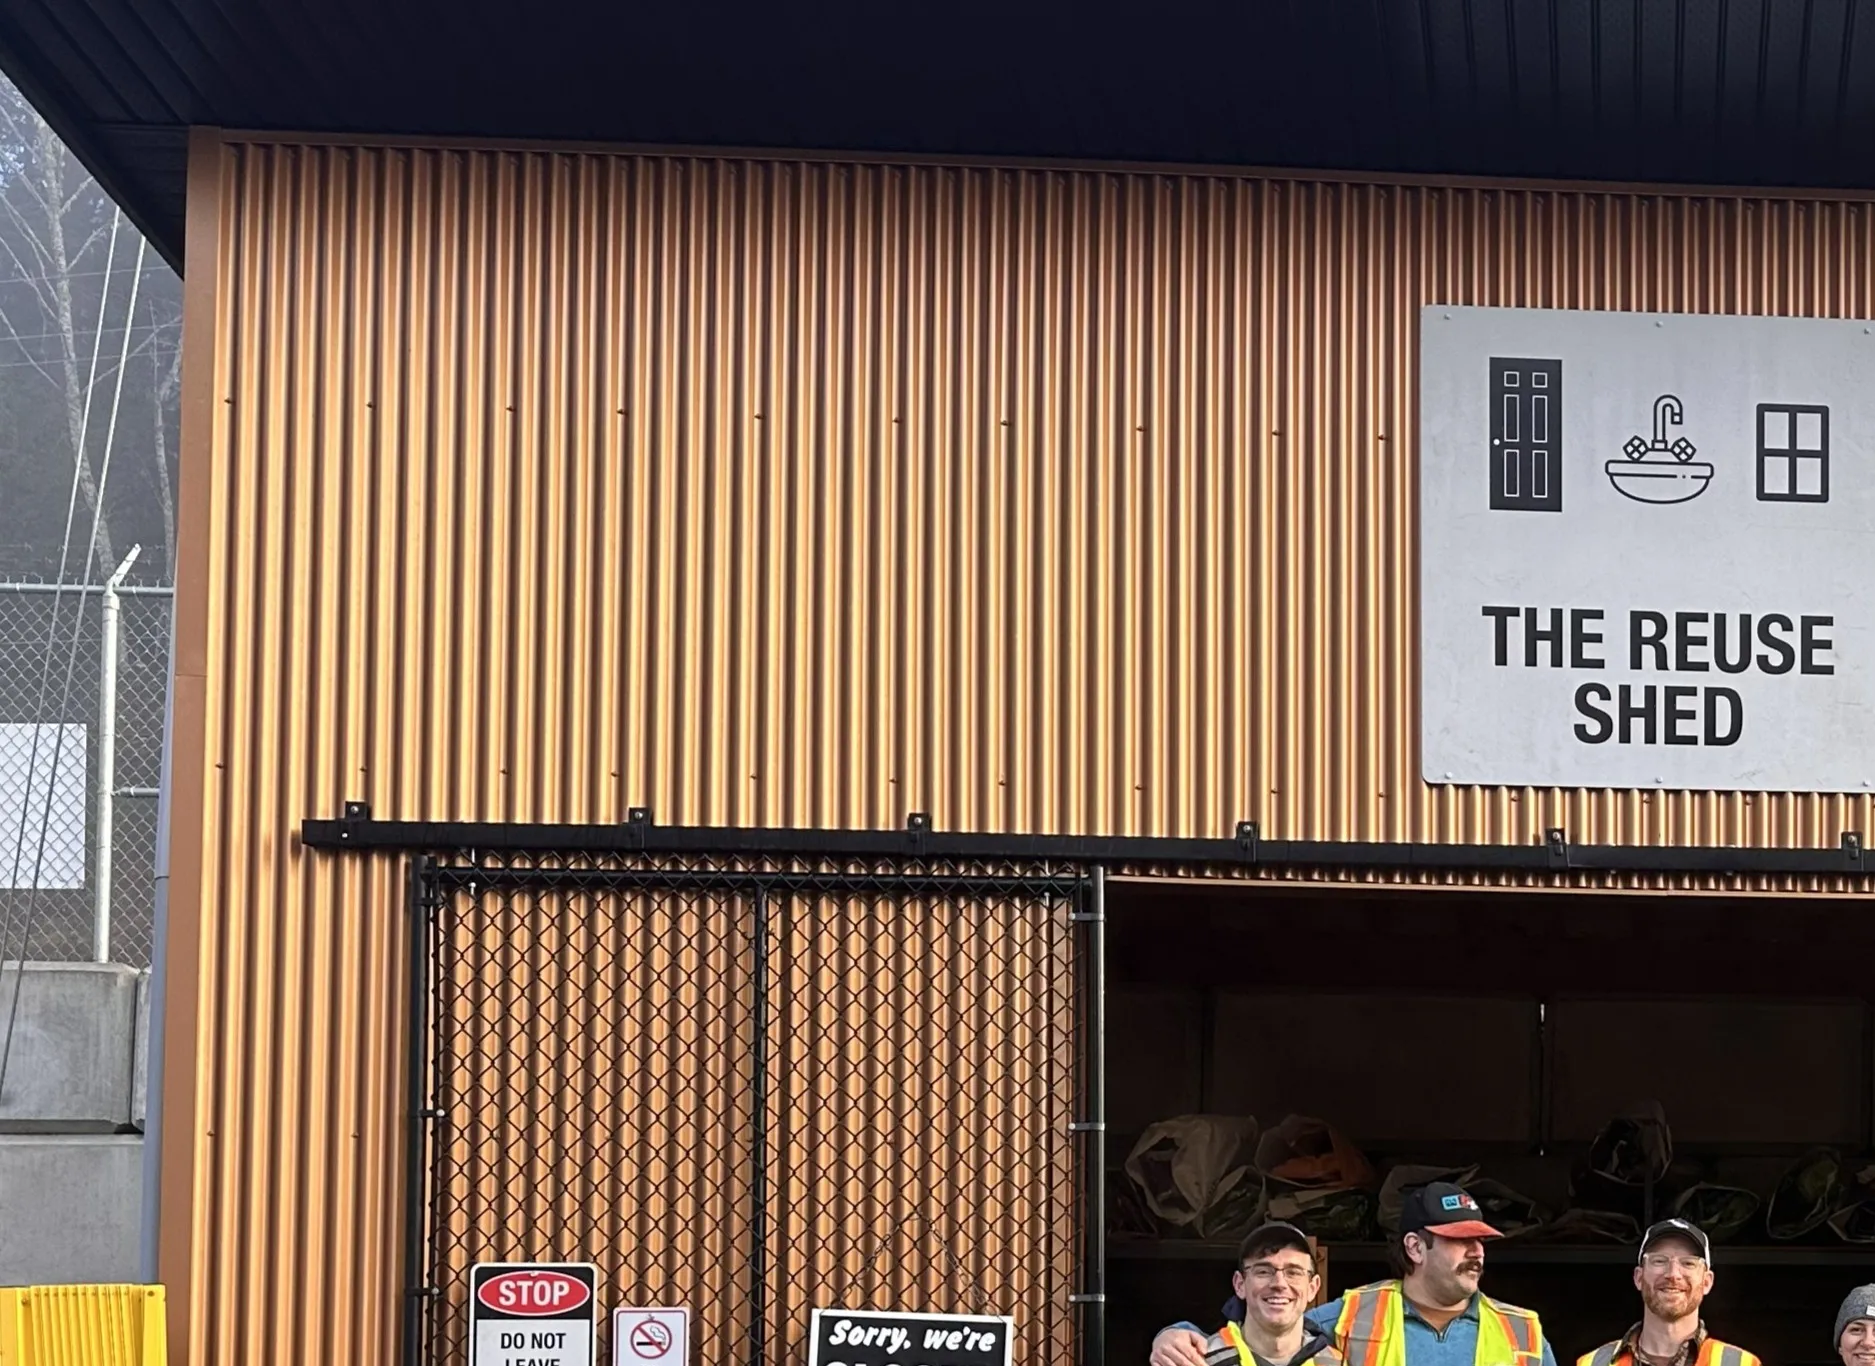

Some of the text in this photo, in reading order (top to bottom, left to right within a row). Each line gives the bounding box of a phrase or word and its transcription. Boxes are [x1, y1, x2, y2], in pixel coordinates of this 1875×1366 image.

[1481, 605, 1835, 676] THE REUSE
[1573, 682, 1744, 747] SHED
[499, 1280, 570, 1306] STOP
[500, 1333, 567, 1350] DO NOT
[828, 1319, 996, 1355] Sorry, we're
